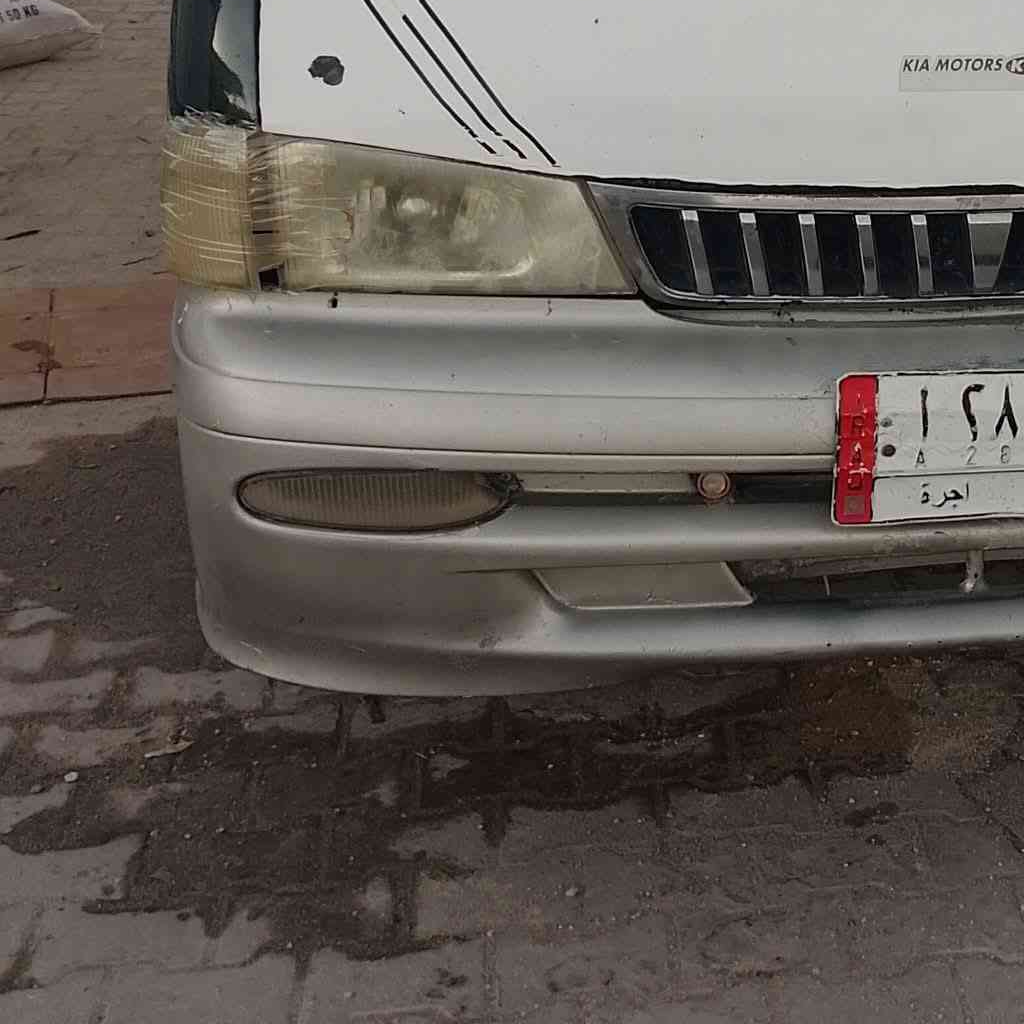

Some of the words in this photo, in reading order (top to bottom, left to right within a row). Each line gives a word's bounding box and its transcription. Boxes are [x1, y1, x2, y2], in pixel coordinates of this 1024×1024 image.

[23, 4, 40, 18] KG
[902, 58, 930, 73] KIA
[935, 58, 1003, 72] MOTORS
